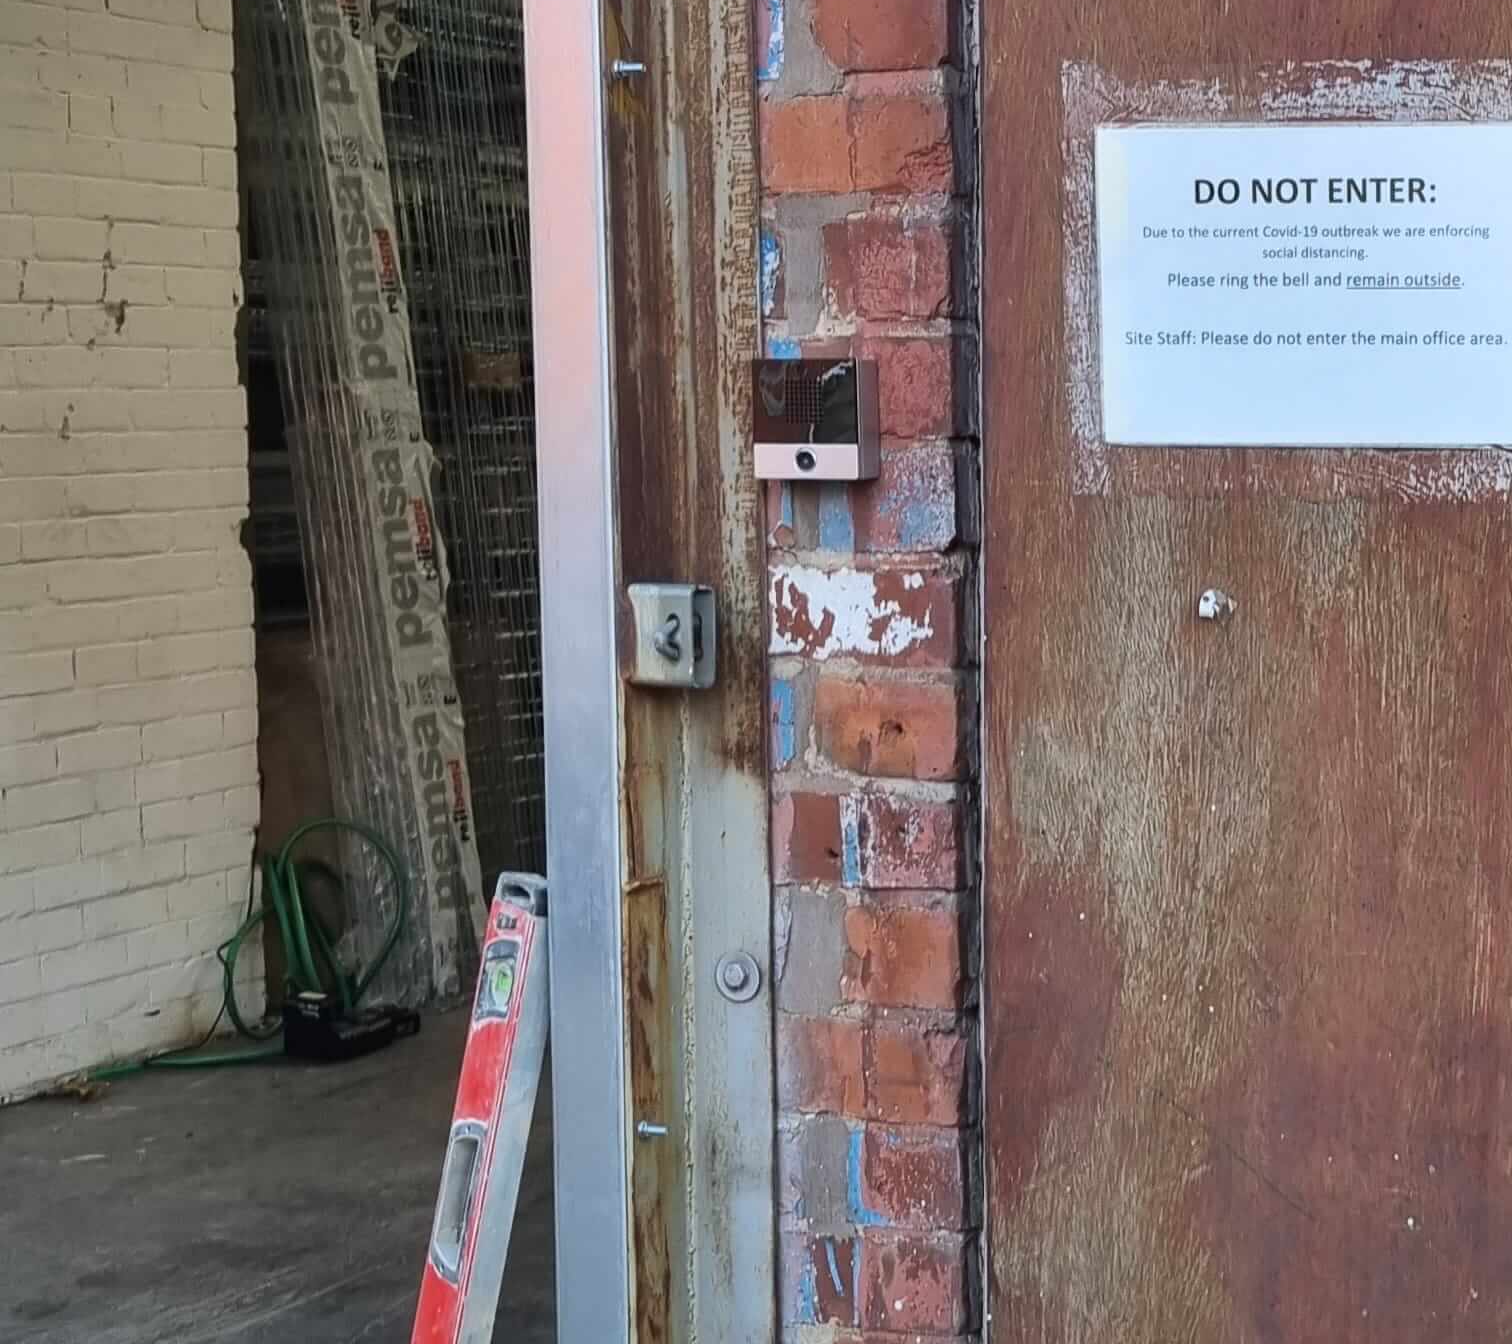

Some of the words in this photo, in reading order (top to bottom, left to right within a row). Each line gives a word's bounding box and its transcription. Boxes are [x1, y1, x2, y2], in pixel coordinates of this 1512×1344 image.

[1194, 178, 1240, 205] DO
[1252, 178, 1318, 205] NOT
[1328, 177, 1437, 204] ENTER:
[1142, 225, 1168, 239] Due
[1172, 227, 1185, 239] to
[1188, 225, 1210, 238] the
[1212, 226, 1259, 239] current
[1262, 225, 1318, 238] Covid-19
[1321, 225, 1379, 238] outbreak
[1383, 227, 1401, 238] we
[1405, 227, 1426, 238] are
[1429, 224, 1490, 240] enforcing
[1262, 246, 1298, 259] social
[1301, 246, 1369, 261] distancing.
[334, 176, 398, 380] pemsa
[1168, 272, 1216, 287] Please
[1220, 273, 1249, 290] ring
[1253, 272, 1279, 287] the
[1283, 272, 1310, 287] bell
[1313, 272, 1342, 287] and
[1346, 272, 1400, 288] remain
[1404, 272, 1465, 288] outside.
[1125, 331, 1153, 345] Site
[1157, 330, 1197, 345] Staff:
[1201, 331, 1249, 346] Please
[1253, 331, 1273, 346] do
[1276, 332, 1302, 346] not
[1306, 332, 1347, 346] enter
[1351, 331, 1377, 346] the
[1381, 331, 1418, 346] main
[1422, 330, 1466, 346] office
[1470, 333, 1508, 346] area.
[371, 447, 433, 648] pemsa
